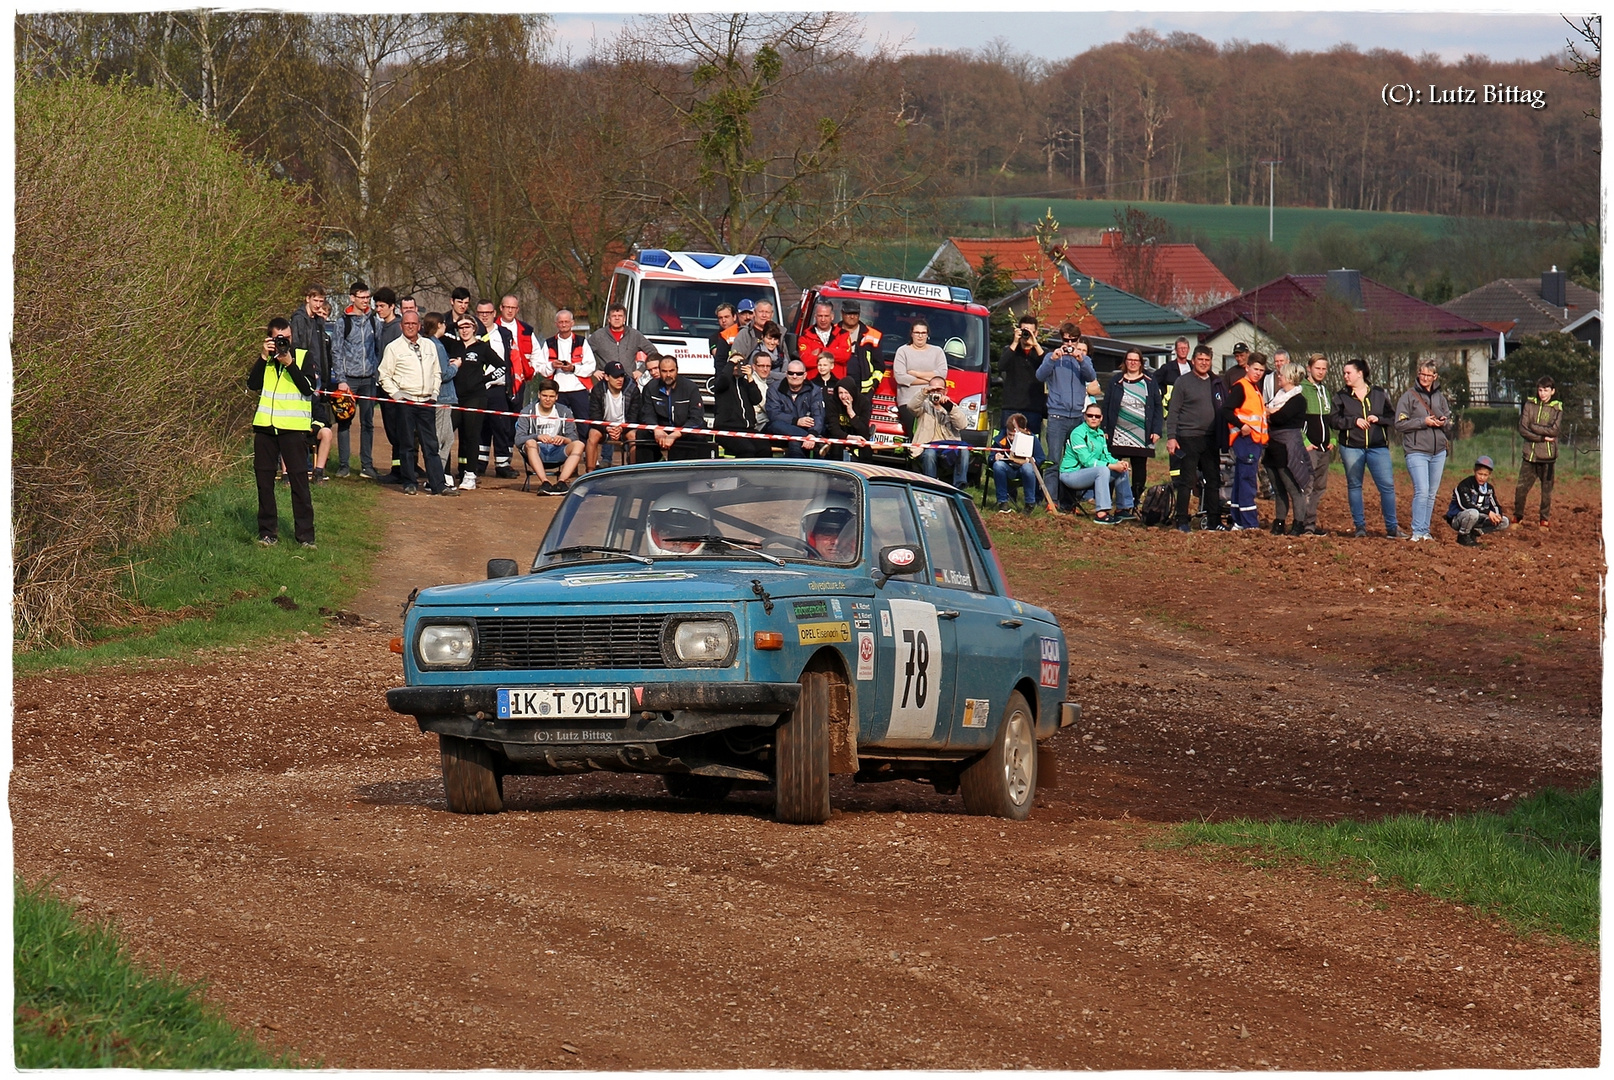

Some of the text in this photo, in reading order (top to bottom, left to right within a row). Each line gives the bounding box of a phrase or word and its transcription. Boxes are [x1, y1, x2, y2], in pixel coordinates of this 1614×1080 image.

[870, 279, 942, 297] FEUERWEHR
[942, 569, 972, 587] K. Richert
[801, 627, 838, 639] OPEL Eisenach
[1041, 638, 1060, 662] LIQUI
[901, 629, 929, 709] 78
[1041, 662, 1060, 686] MOLY
[511, 691, 626, 714] IK T 901H
